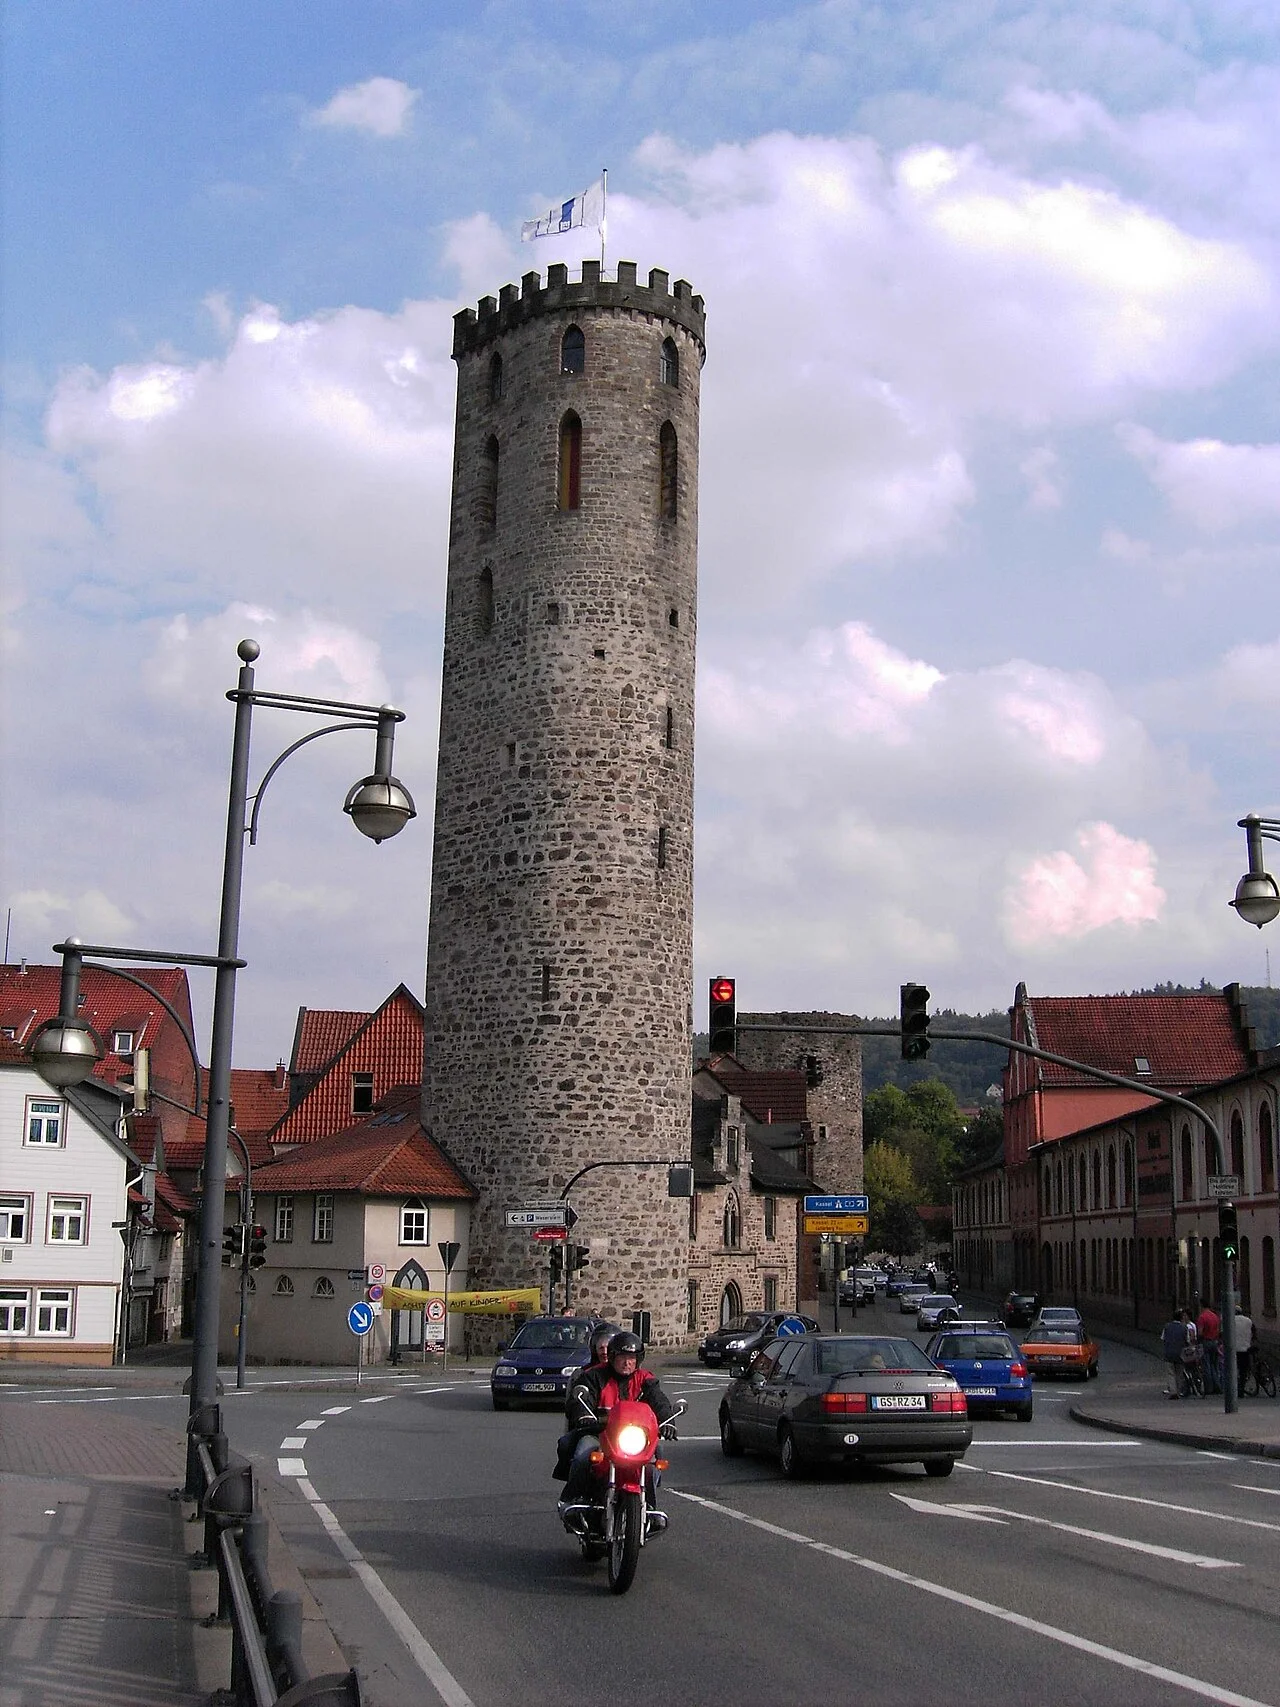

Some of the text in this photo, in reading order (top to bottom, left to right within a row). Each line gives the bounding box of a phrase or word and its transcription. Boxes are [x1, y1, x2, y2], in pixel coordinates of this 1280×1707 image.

[880, 1397, 922, 1407] GS RZ 34
